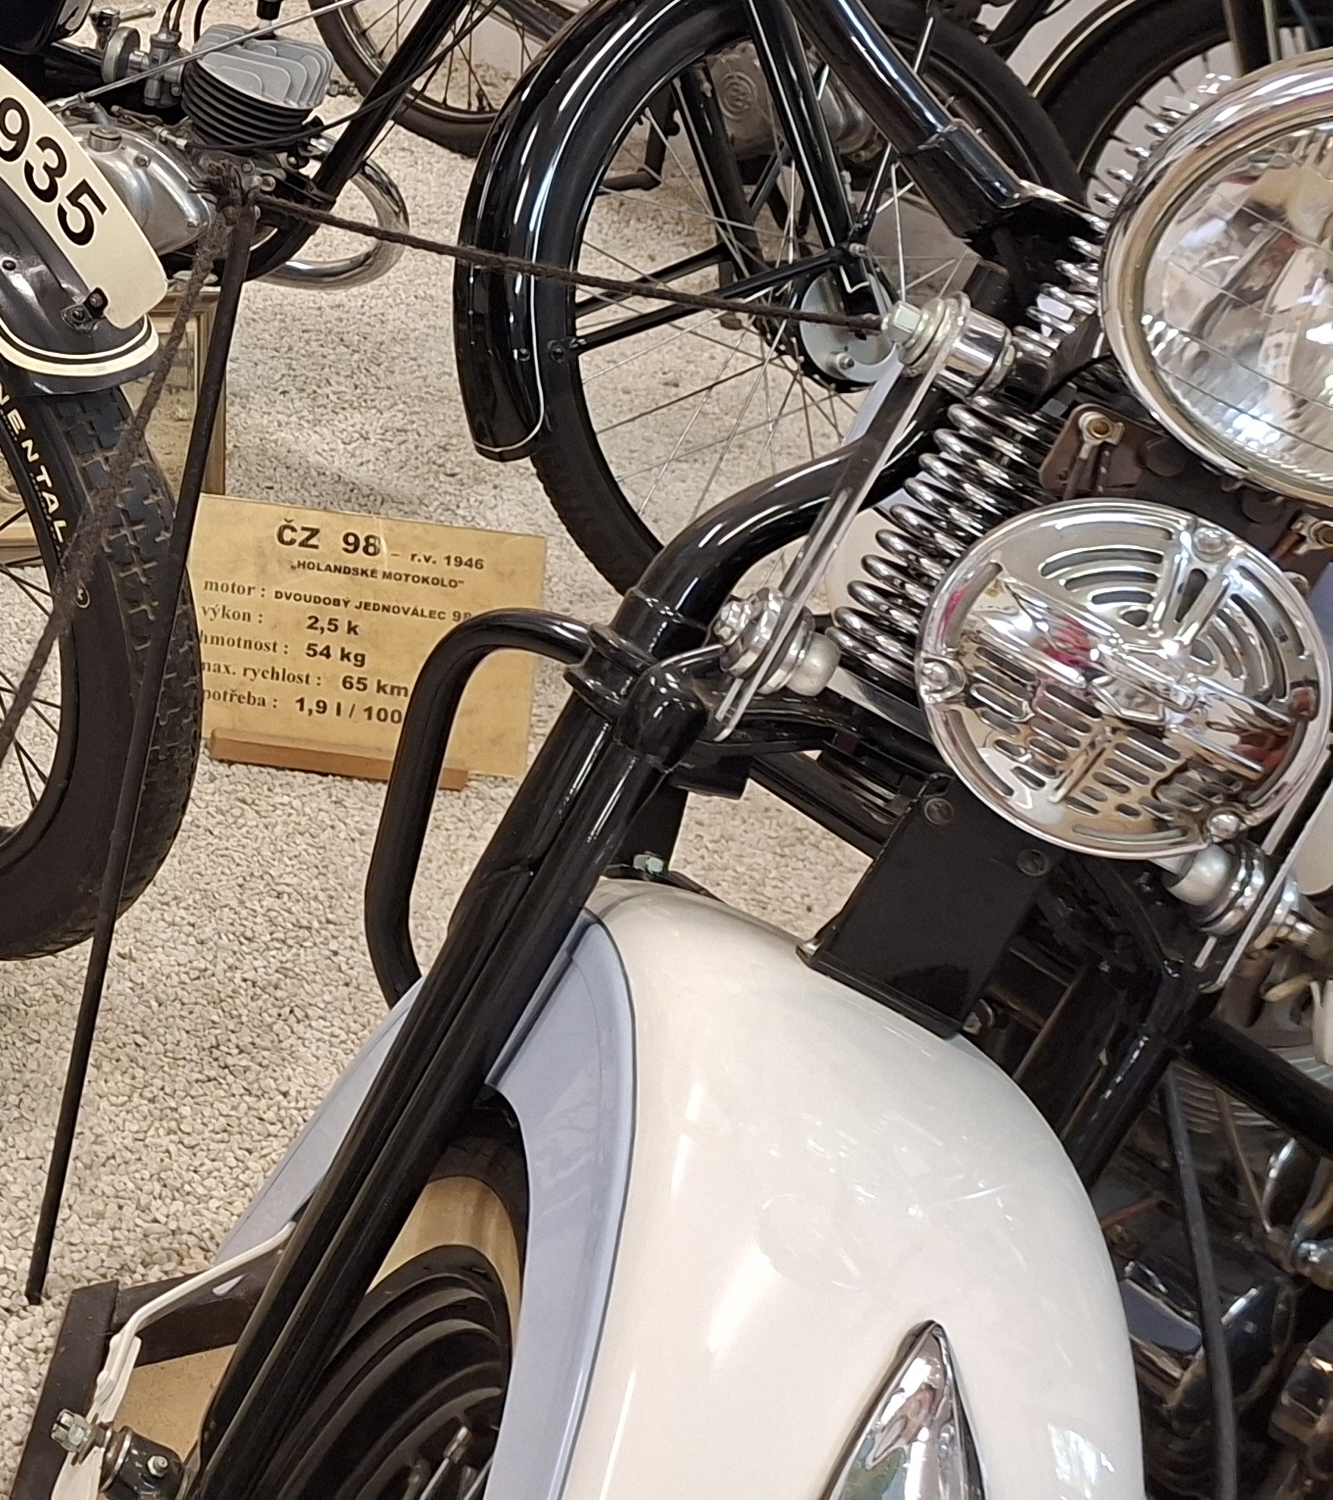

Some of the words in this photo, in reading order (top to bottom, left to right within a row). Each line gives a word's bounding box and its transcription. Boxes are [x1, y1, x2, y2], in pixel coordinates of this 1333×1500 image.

[275, 517, 322, 551] ČZ
[341, 531, 383, 558] 98
[409, 548, 437, 566] r.v.
[442, 552, 486, 572] 1946
[202, 577, 257, 598] motor
[273, 588, 351, 610] DVOUDOBÝ
[353, 597, 447, 623] JEDNOVÁLEC
[200, 603, 254, 626] výkon
[305, 614, 340, 637] 2,5
[345, 619, 361, 637] k
[304, 642, 333, 662] 54
[338, 647, 368, 669] kg
[241, 664, 311, 688] rychlost
[340, 673, 369, 694] 65
[375, 676, 410, 699] km
[201, 685, 268, 709] potřeba
[294, 695, 329, 719] 1,9
[362, 704, 404, 726] 100
